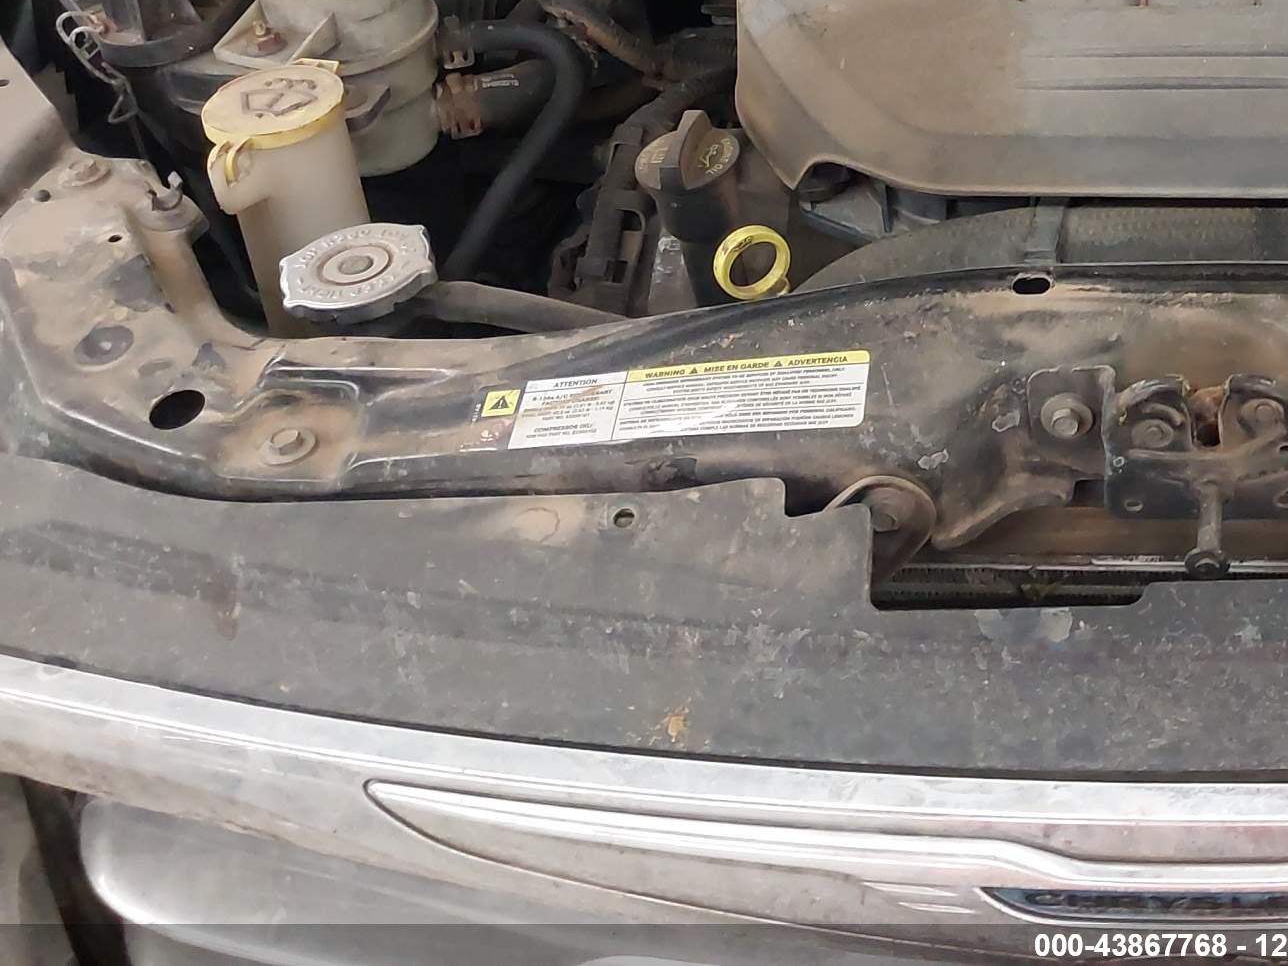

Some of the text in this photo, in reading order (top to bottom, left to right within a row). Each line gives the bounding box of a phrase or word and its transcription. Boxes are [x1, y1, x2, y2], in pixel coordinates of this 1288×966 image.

[645, 369, 685, 378] WARNING
[740, 361, 769, 369] GARDE
[787, 354, 847, 367] ADVERTENCIA
[553, 378, 597, 387] ATTENTION
